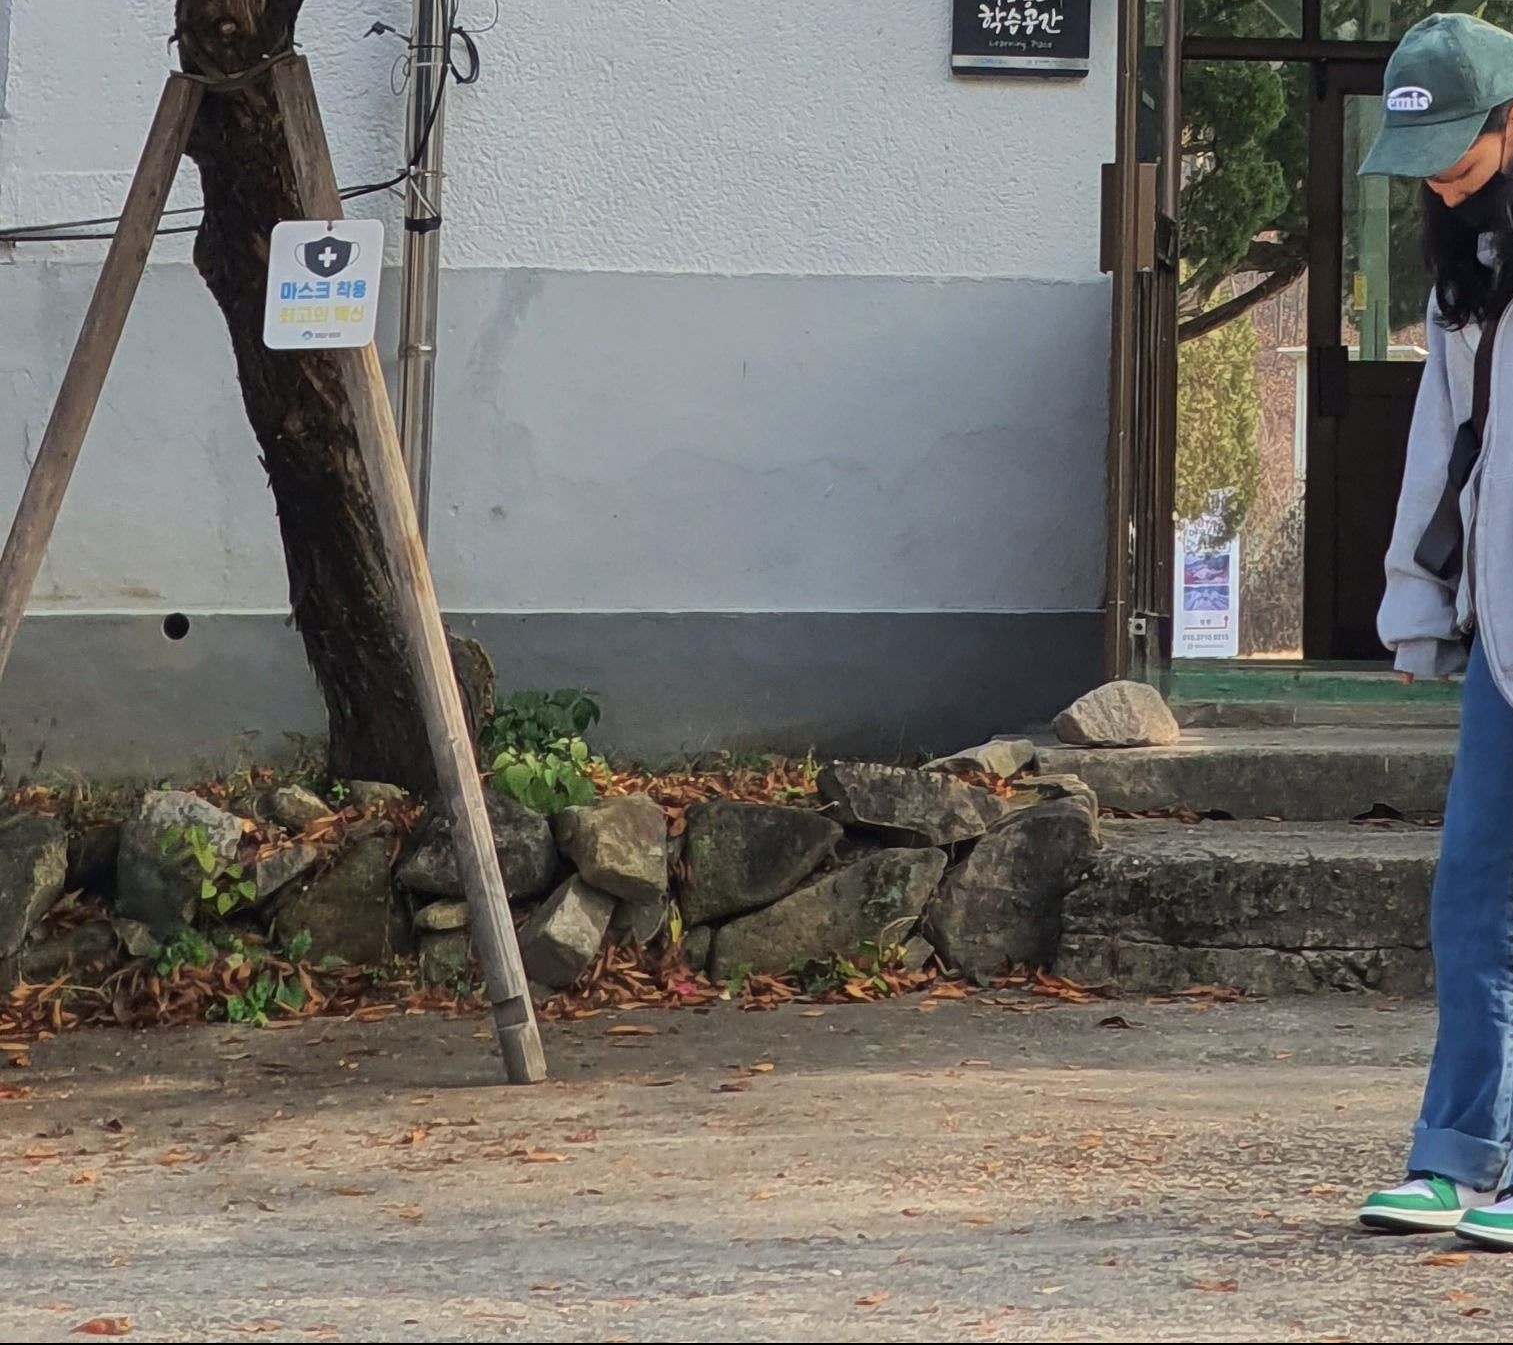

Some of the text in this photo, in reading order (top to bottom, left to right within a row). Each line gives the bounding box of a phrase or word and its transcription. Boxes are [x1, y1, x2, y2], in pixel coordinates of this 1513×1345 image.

[977, 3, 1063, 35] 학습공간
[1387, 92, 1429, 110] emis
[280, 280, 367, 300] 마스크 착용
